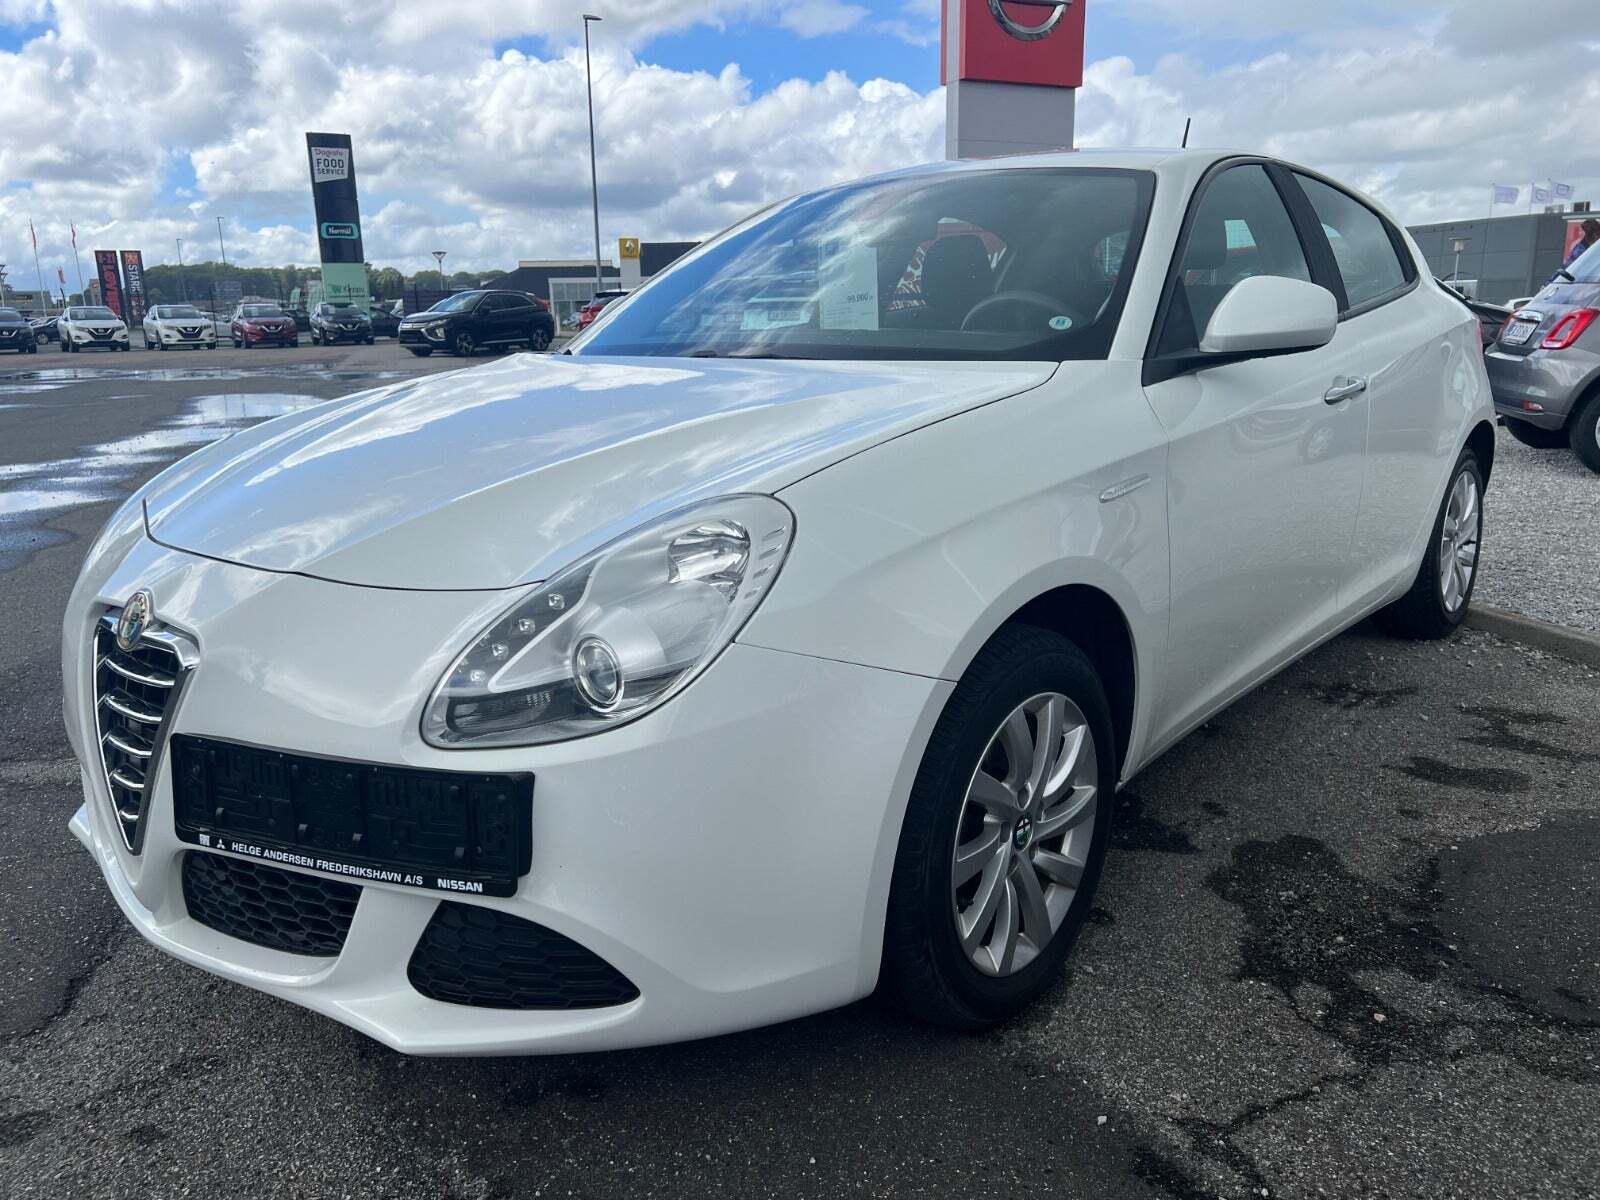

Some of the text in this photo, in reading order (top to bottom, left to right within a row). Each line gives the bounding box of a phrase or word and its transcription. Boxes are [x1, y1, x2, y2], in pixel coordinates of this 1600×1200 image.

[316, 157, 345, 169] FOOD
[317, 168, 345, 176] SERVICE
[328, 226, 352, 235] Normal
[128, 264, 142, 293] STARK
[231, 841, 484, 893] HELGE ANDERSEN FREDERIKSHAVN A/S NISSAN
